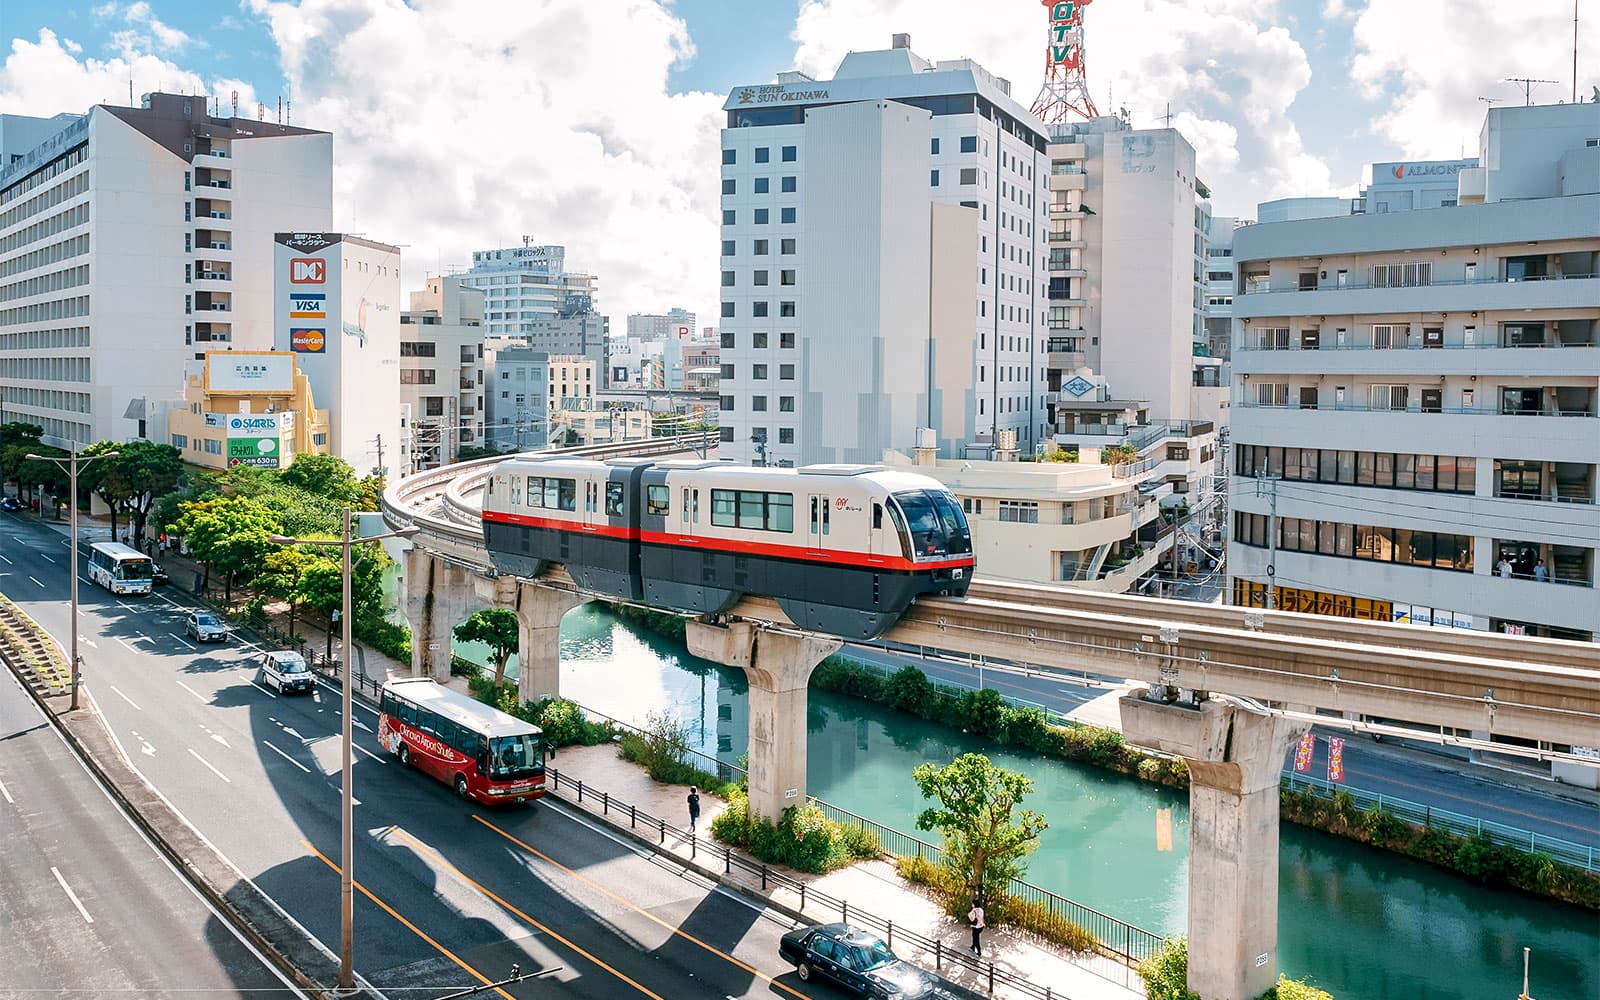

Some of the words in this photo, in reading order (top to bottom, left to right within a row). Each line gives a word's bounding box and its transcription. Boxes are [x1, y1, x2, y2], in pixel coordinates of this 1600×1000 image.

[757, 94, 779, 103] SUN
[781, 90, 830, 102] OKINAWA
[759, 86, 786, 94] HOTEL
[295, 301, 321, 312] VISA
[679, 327, 689, 340] P
[293, 337, 324, 345] MasterCard
[1273, 590, 1389, 622] ランクルーム
[399, 723, 421, 744] Okinawa
[420, 735, 437, 752] Airport
[436, 742, 455, 761] Shuttle
